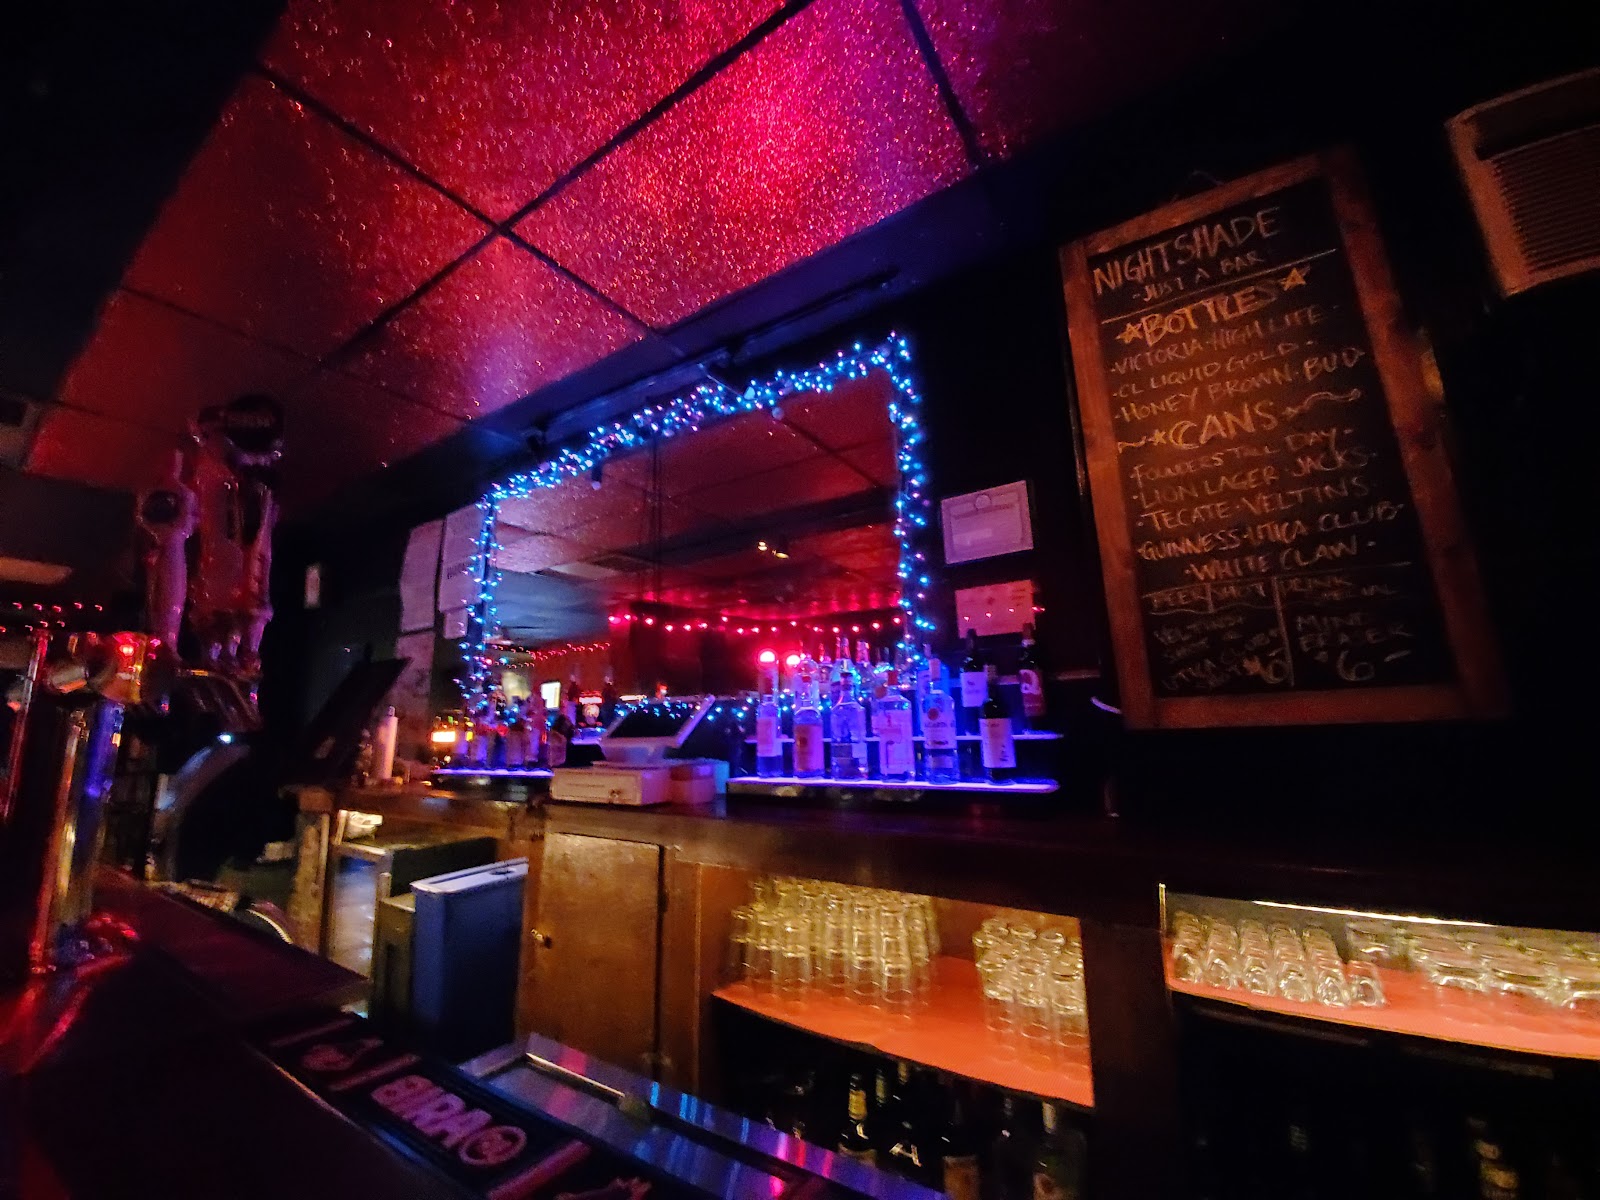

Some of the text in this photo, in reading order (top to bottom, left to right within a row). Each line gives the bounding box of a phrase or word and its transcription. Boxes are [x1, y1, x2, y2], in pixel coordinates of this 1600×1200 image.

[1092, 205, 1281, 296] NIGHTSHADE
[1220, 250, 1266, 276] BAR
[1139, 279, 1279, 348] BOTTLES
[1119, 347, 1363, 423] HONEY BROWN BUD
[1150, 361, 1222, 389] LIQUID
[1227, 342, 1298, 373] GOLD
[1169, 399, 1280, 451] CANS
[1140, 500, 1231, 533] TECATE
[1141, 486, 1199, 510] LION
[1140, 527, 1242, 561] GUINNESS
